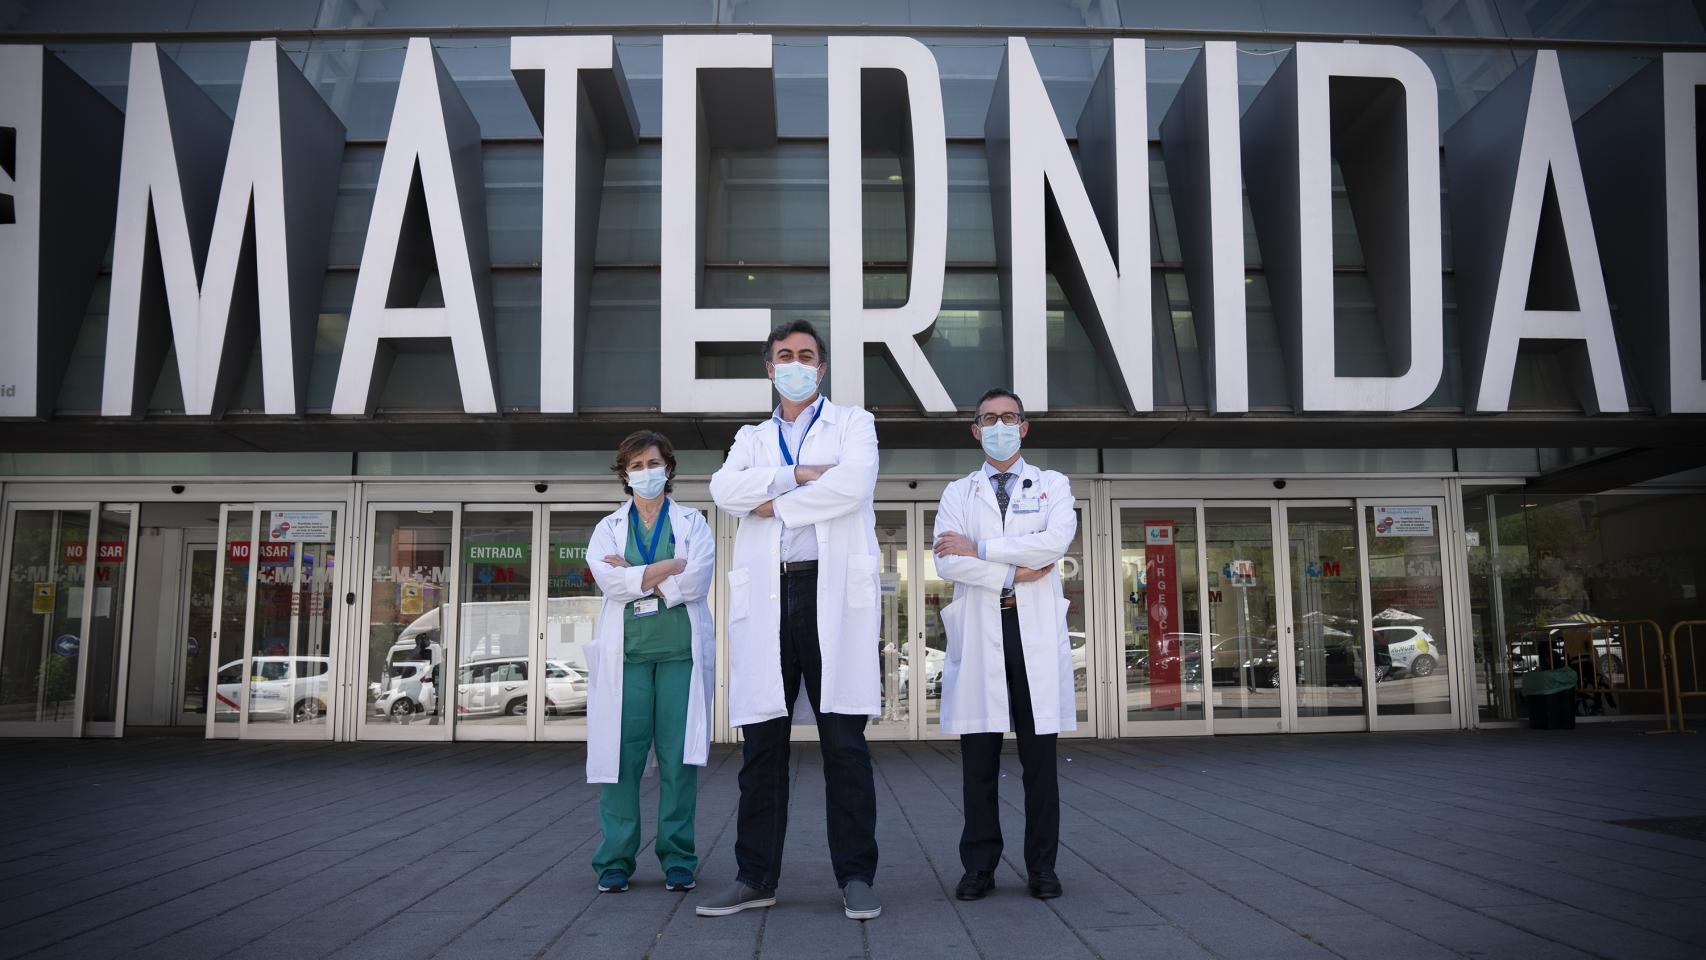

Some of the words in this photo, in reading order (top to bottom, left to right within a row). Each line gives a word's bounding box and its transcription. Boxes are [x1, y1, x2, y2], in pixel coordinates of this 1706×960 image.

[101, 34, 1706, 416] MATERNIDA
[67, 546, 82, 557] NO
[97, 545, 122, 557] SAR
[232, 545, 249, 557] NO
[259, 545, 288, 557] ASAR
[470, 547, 522, 559] ENTRADA
[559, 547, 588, 559] ENTR
